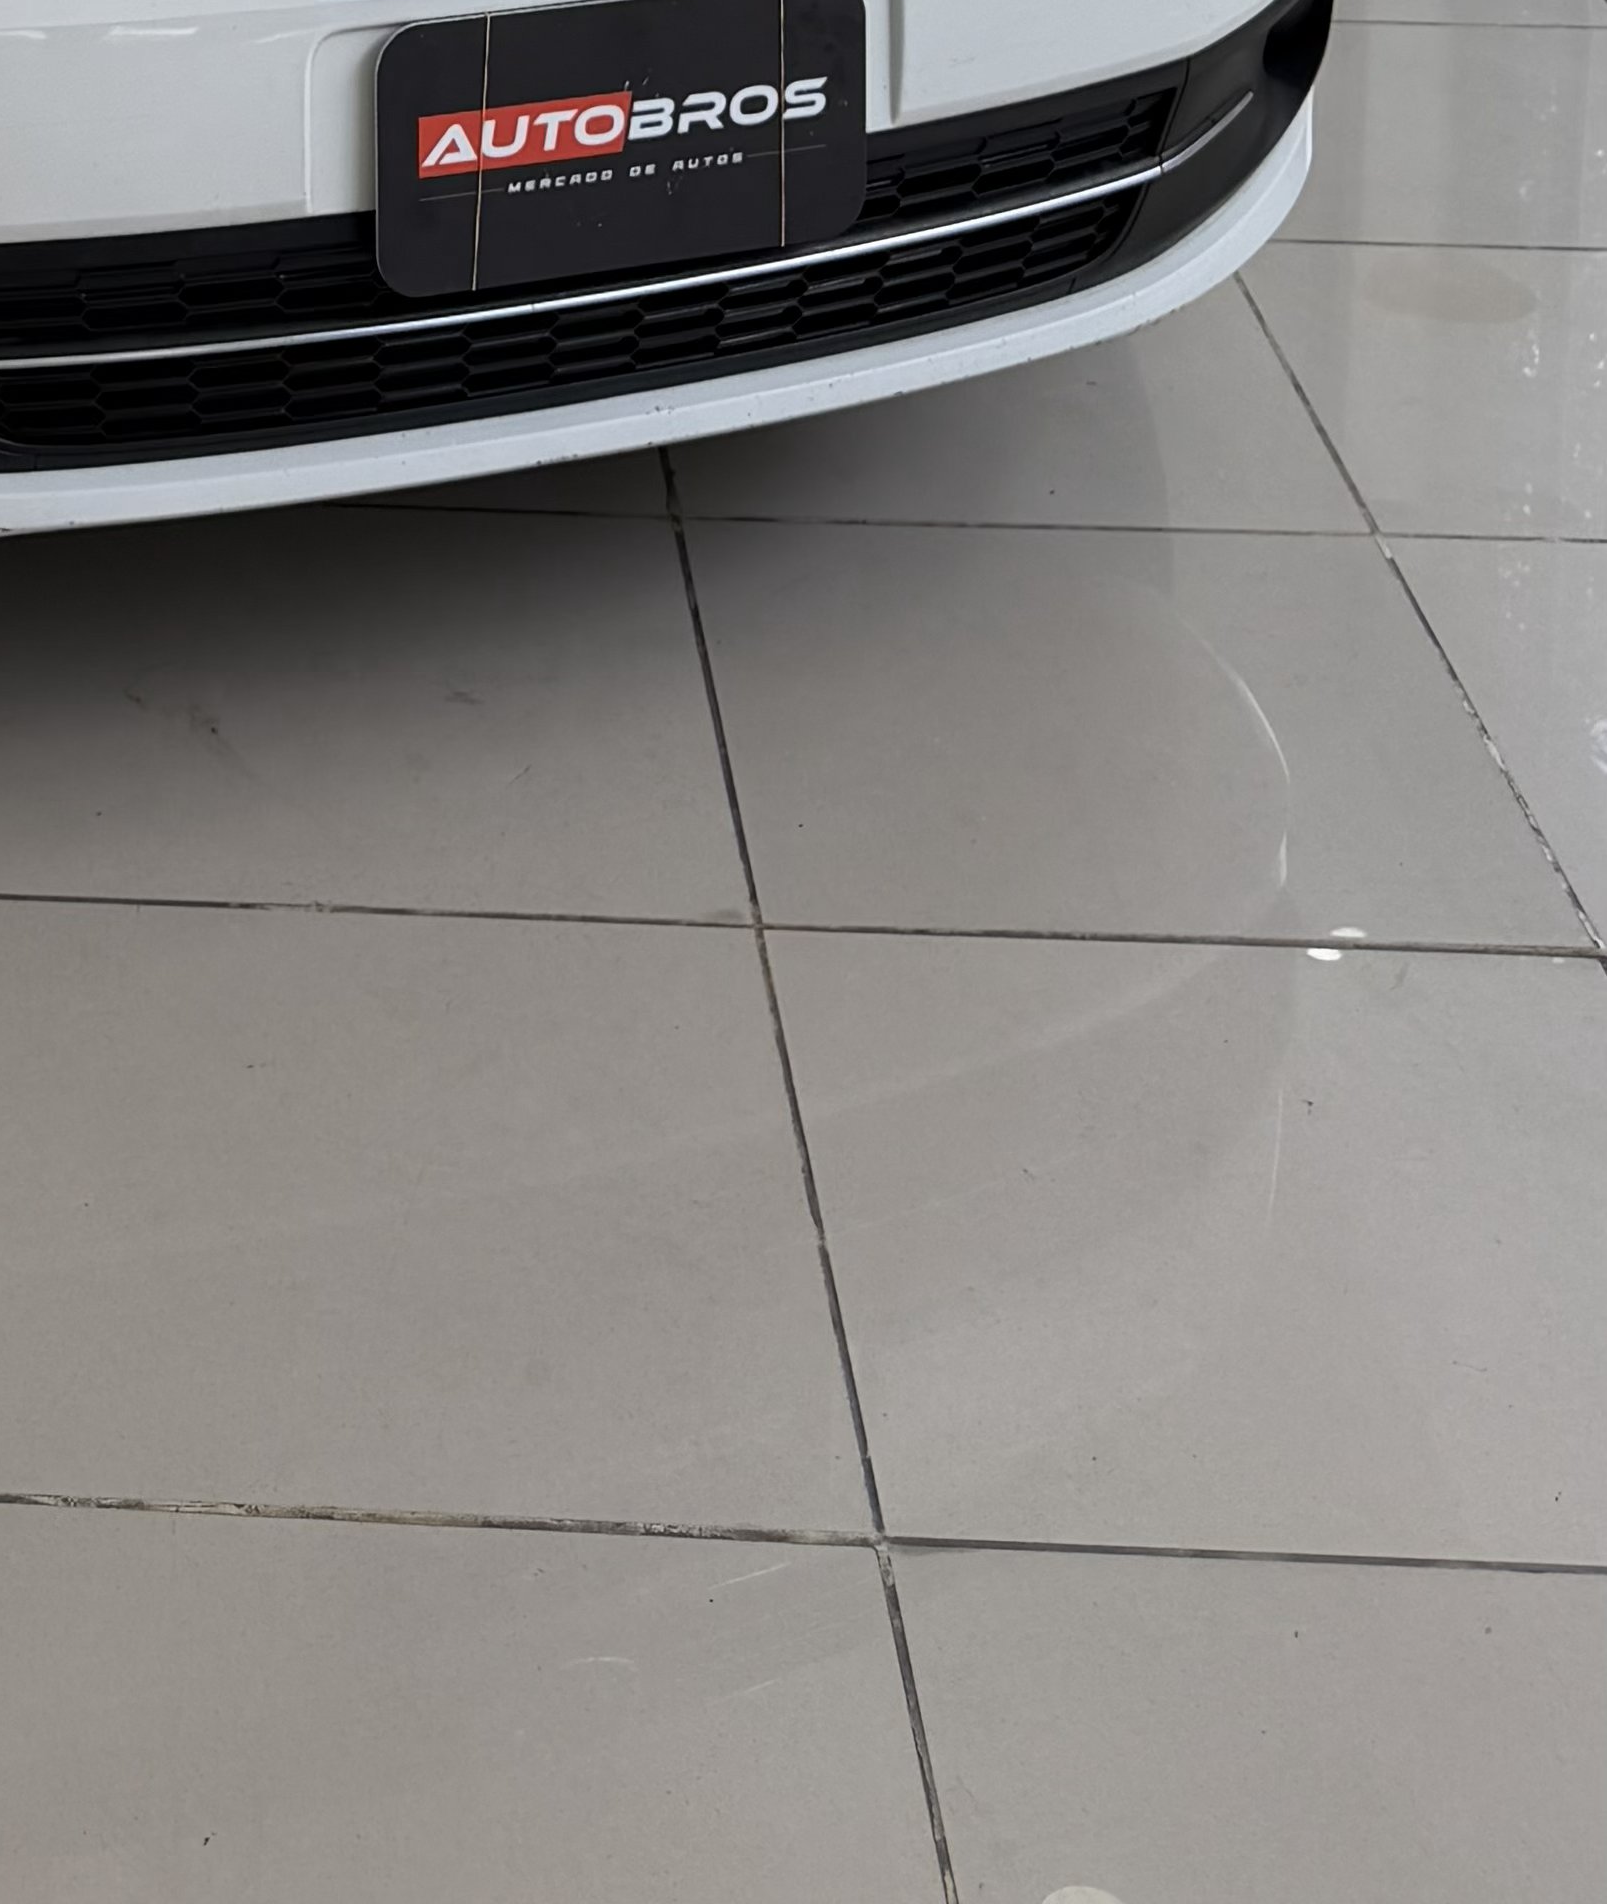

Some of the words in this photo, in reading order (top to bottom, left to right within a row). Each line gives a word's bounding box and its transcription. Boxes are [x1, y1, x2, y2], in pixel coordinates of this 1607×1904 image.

[421, 76, 829, 168] AUTOBROS
[507, 168, 614, 194] MERCADO
[629, 163, 656, 178] DE
[671, 151, 744, 173] AUTOS
